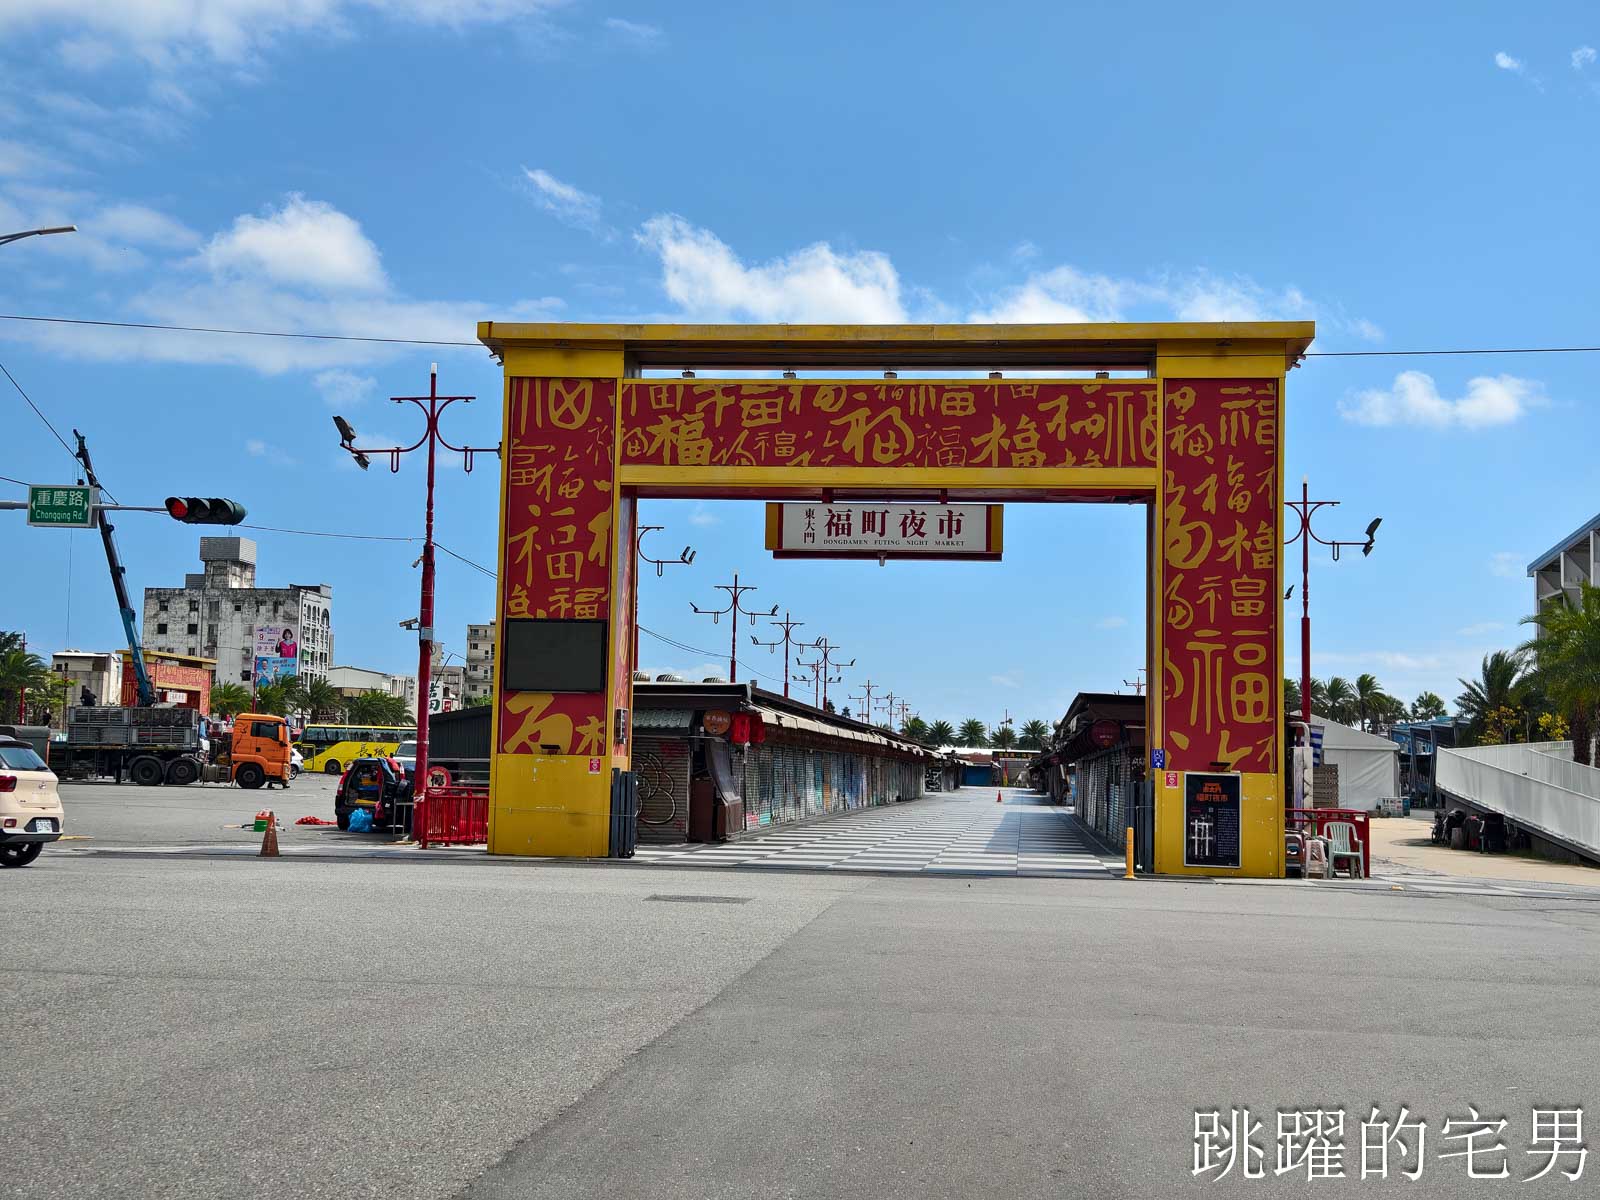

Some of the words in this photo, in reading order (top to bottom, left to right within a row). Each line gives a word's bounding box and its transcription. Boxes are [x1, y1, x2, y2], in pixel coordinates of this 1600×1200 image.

[36, 490, 84, 506] 重慶路
[36, 510, 71, 522] Chongqing
[803, 508, 816, 544] 東大門
[824, 508, 965, 539] 福町夜市
[1185, 629, 1270, 736] 福
